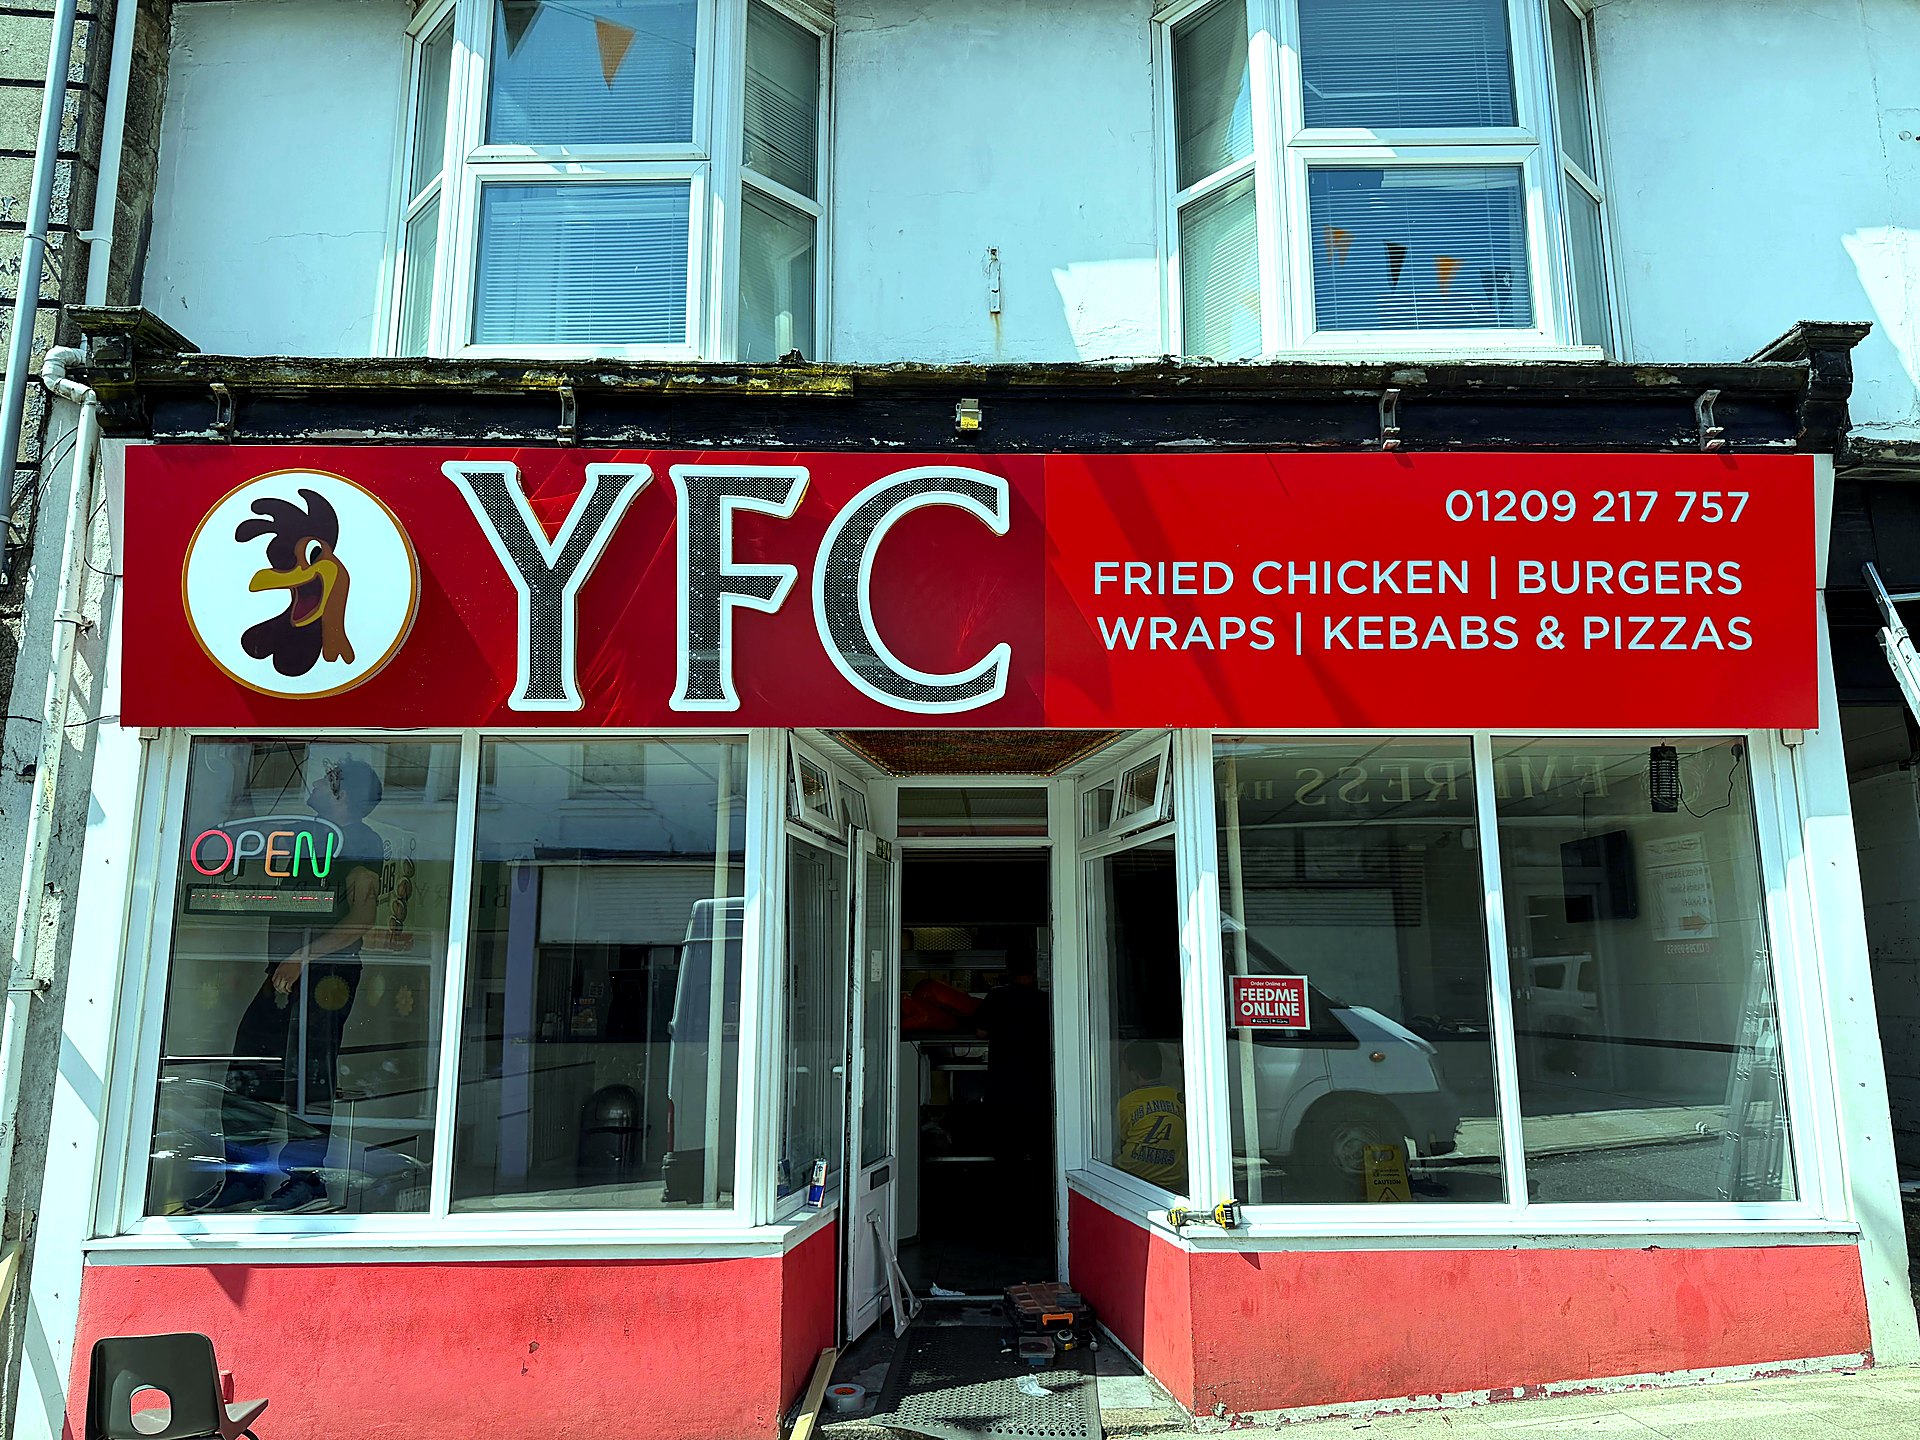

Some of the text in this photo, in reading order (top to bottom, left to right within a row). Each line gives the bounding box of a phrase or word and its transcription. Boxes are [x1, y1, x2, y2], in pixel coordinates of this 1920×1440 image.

[1446, 490, 1749, 522] 01209 217 757
[441, 460, 1011, 714] YFC
[1095, 562, 1233, 594] FRIED
[1253, 561, 1468, 594] CHICKEN
[1519, 561, 1742, 594] BURGERS
[1097, 616, 1274, 650] WRAPS
[1325, 616, 1518, 649] KEBABS
[1536, 616, 1565, 649] &
[1584, 616, 1752, 650] PIZZAS
[190, 829, 334, 878] OPEN
[1240, 988, 1298, 1001] FEEDME
[1241, 1002, 1299, 1016] ONLINE
[1131, 1144, 1175, 1164] LAKERS
